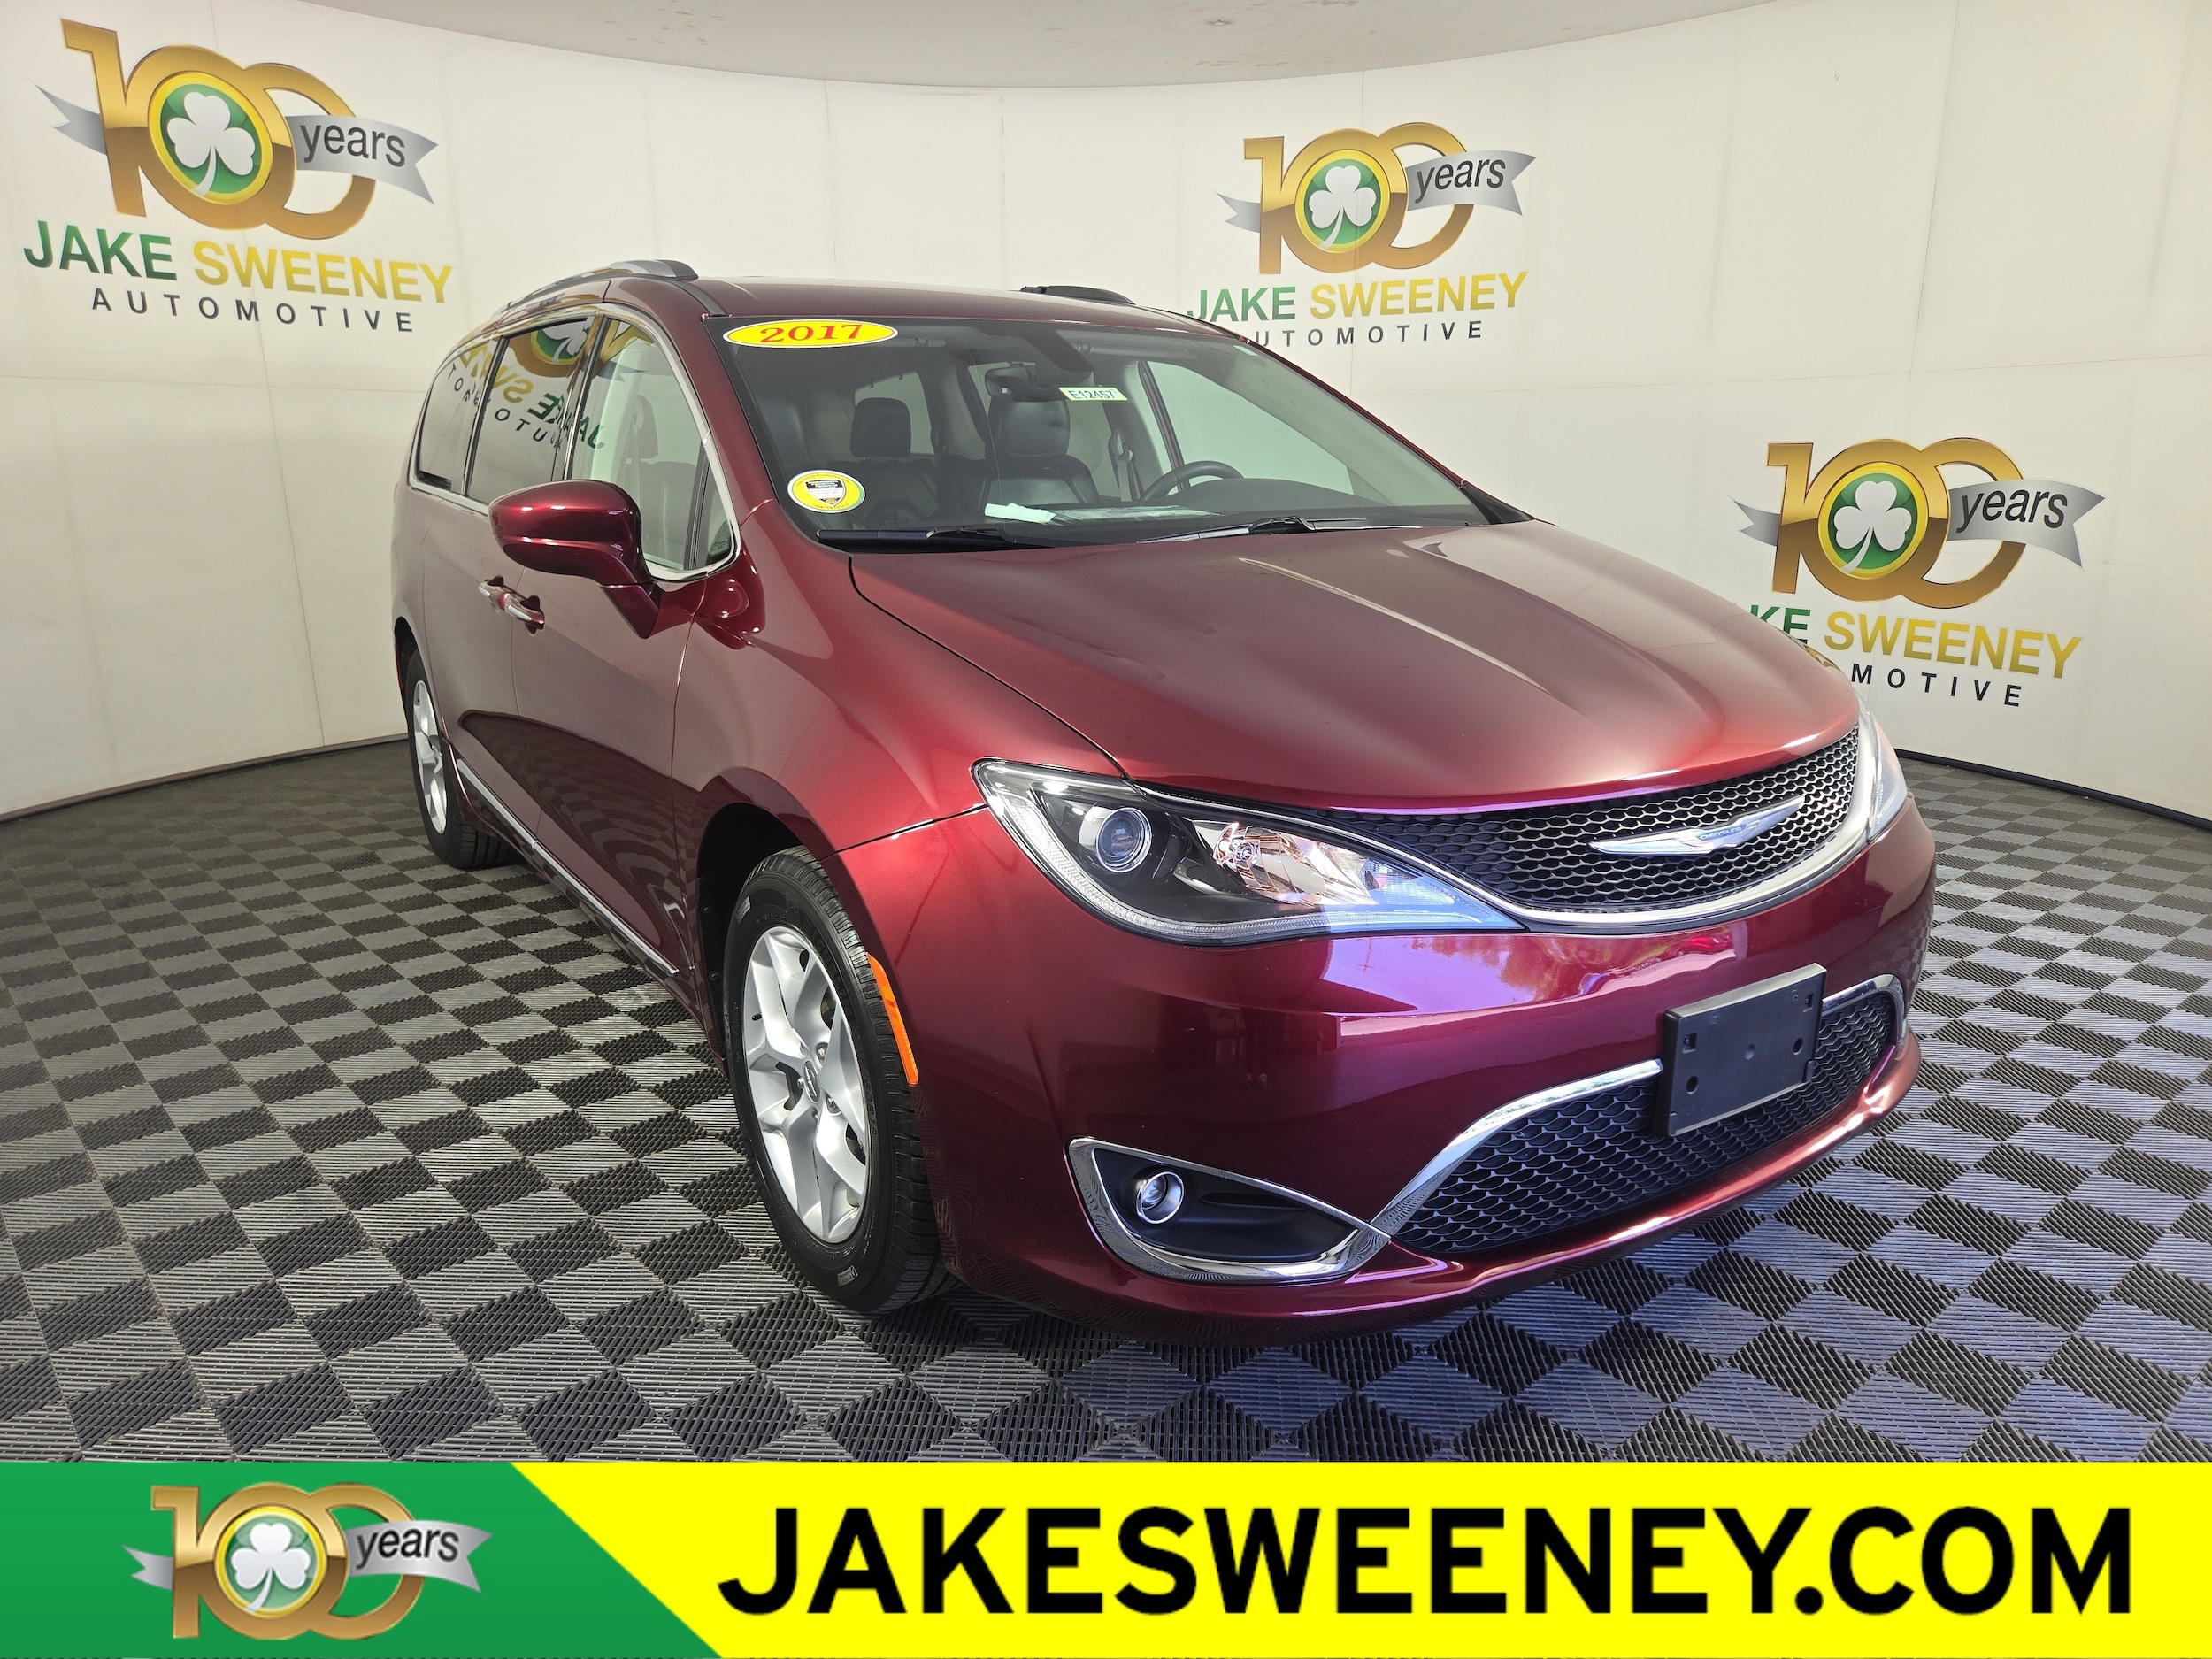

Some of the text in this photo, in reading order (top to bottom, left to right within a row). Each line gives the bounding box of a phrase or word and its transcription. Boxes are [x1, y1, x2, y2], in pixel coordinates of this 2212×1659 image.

[60, 18, 376, 240] 100
[300, 122, 406, 168] years
[1243, 122, 1475, 274] 100
[1416, 157, 1507, 204] years
[24, 220, 453, 303] JAKE SWEENEY
[92, 288, 413, 332] AUTOMOTIVE
[1187, 271, 1529, 322] JAKE SWEENEY
[759, 324, 862, 343] 2017
[1255, 320, 1482, 347] UTOMOTIVE
[1766, 437, 2026, 609] 100
[1955, 489, 2069, 534] years
[1824, 611, 2083, 680] SWEENEY
[1851, 663, 2023, 707] MOTIVE
[1699, 826, 1742, 840] CHRYSLER
